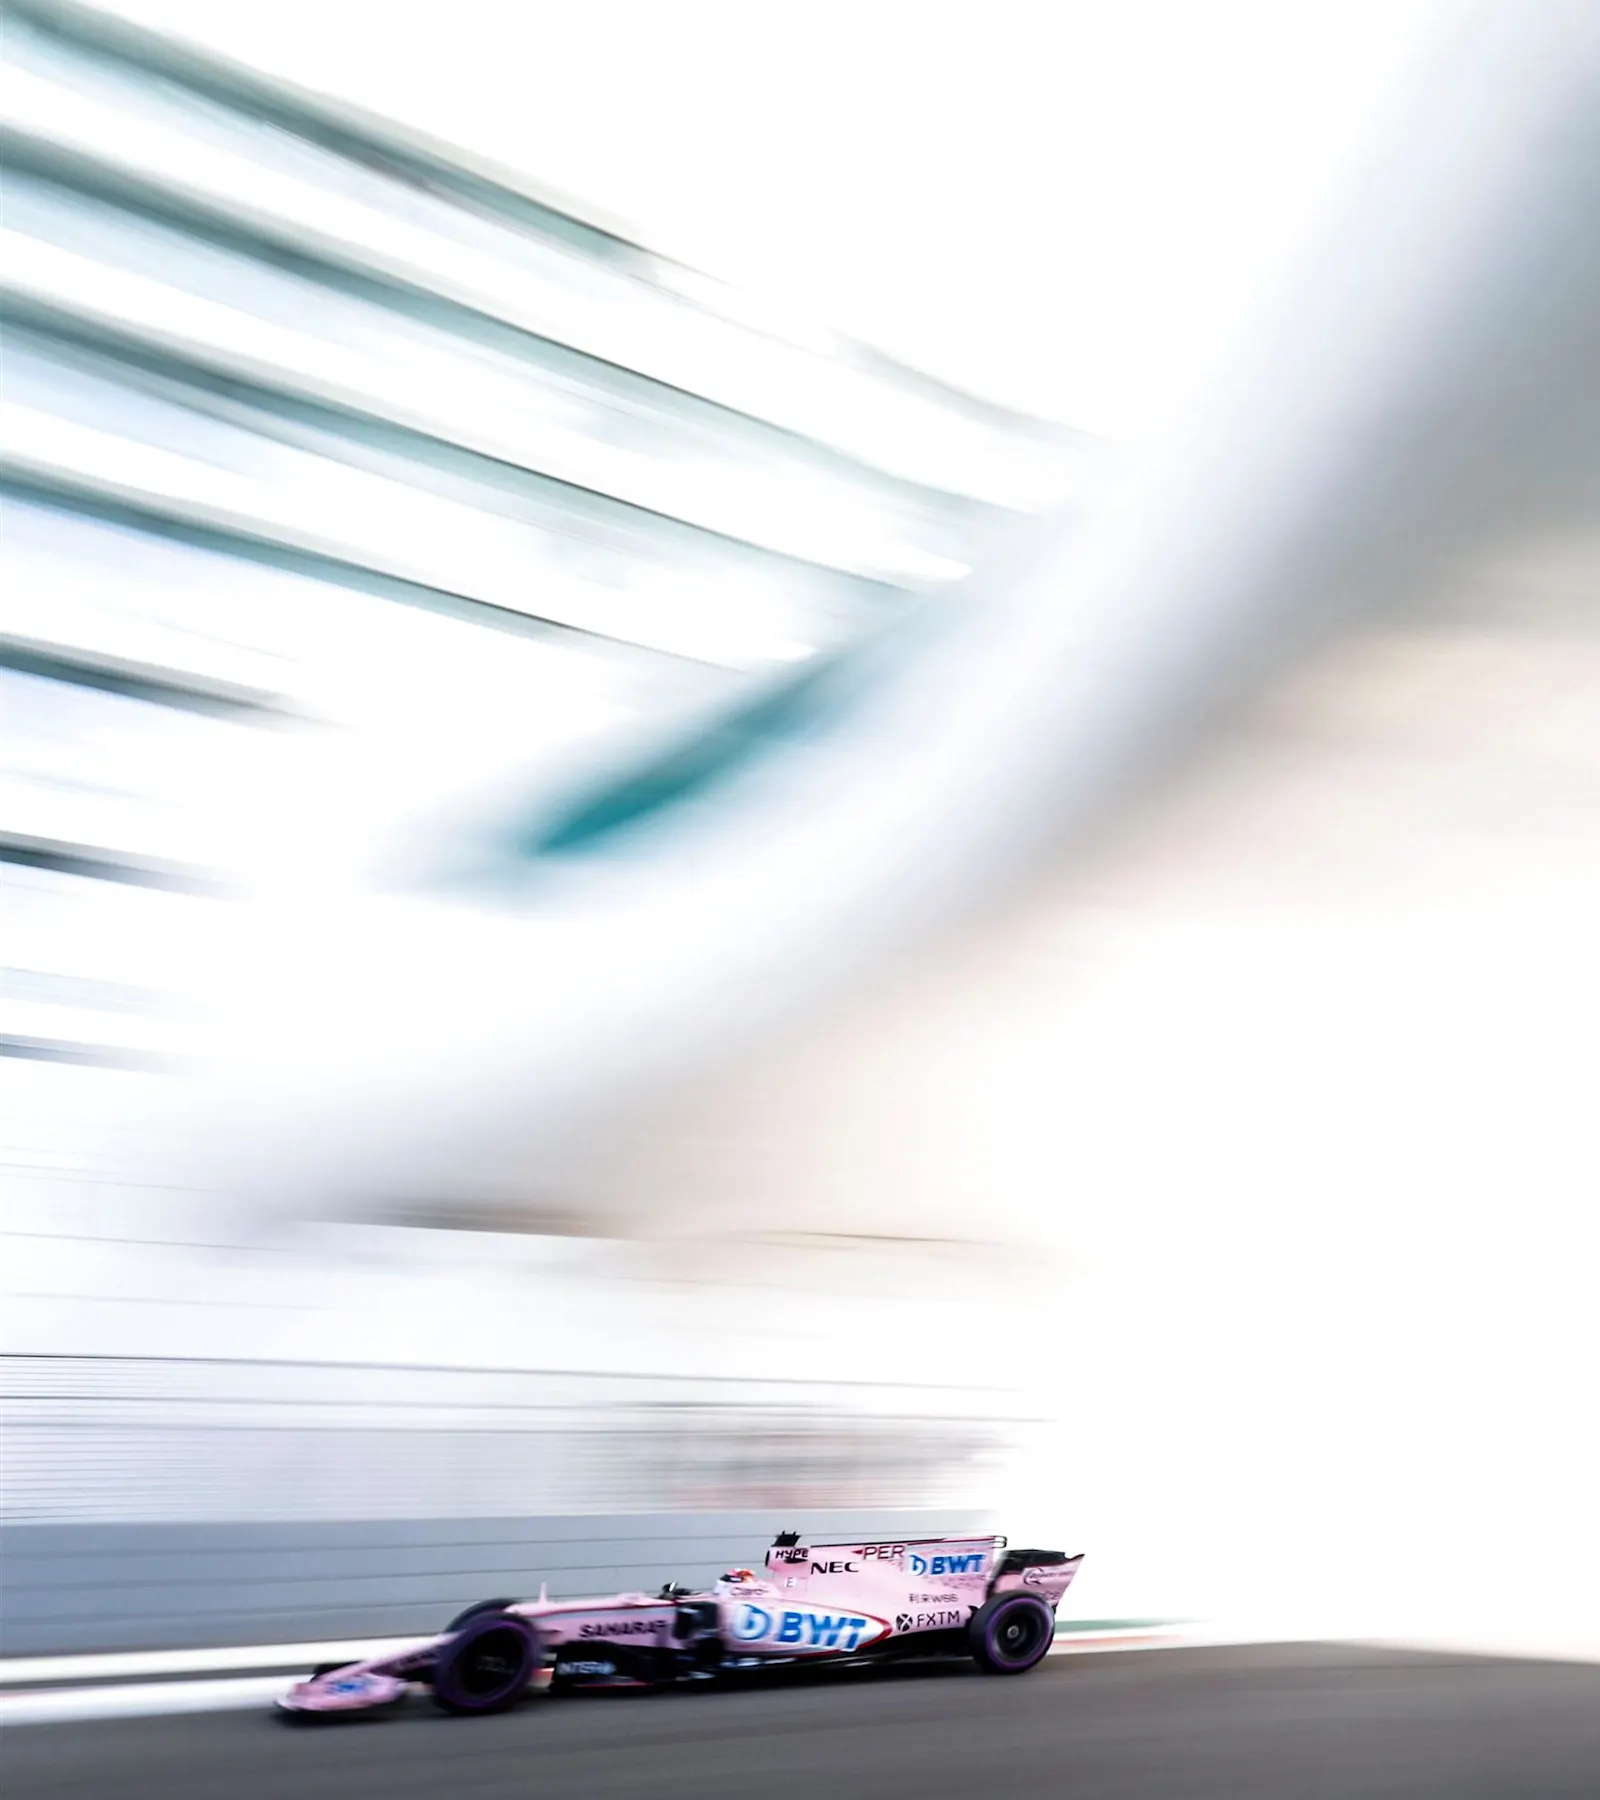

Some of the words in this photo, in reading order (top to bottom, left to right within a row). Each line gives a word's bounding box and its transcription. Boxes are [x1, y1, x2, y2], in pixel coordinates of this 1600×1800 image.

[775, 1547, 809, 1559] HYPE
[862, 1544, 906, 1560] PER
[810, 1561, 860, 1575] NEC
[931, 1553, 986, 1575] BWT
[916, 1610, 961, 1628] FXTM
[776, 1611, 867, 1649] BWT
